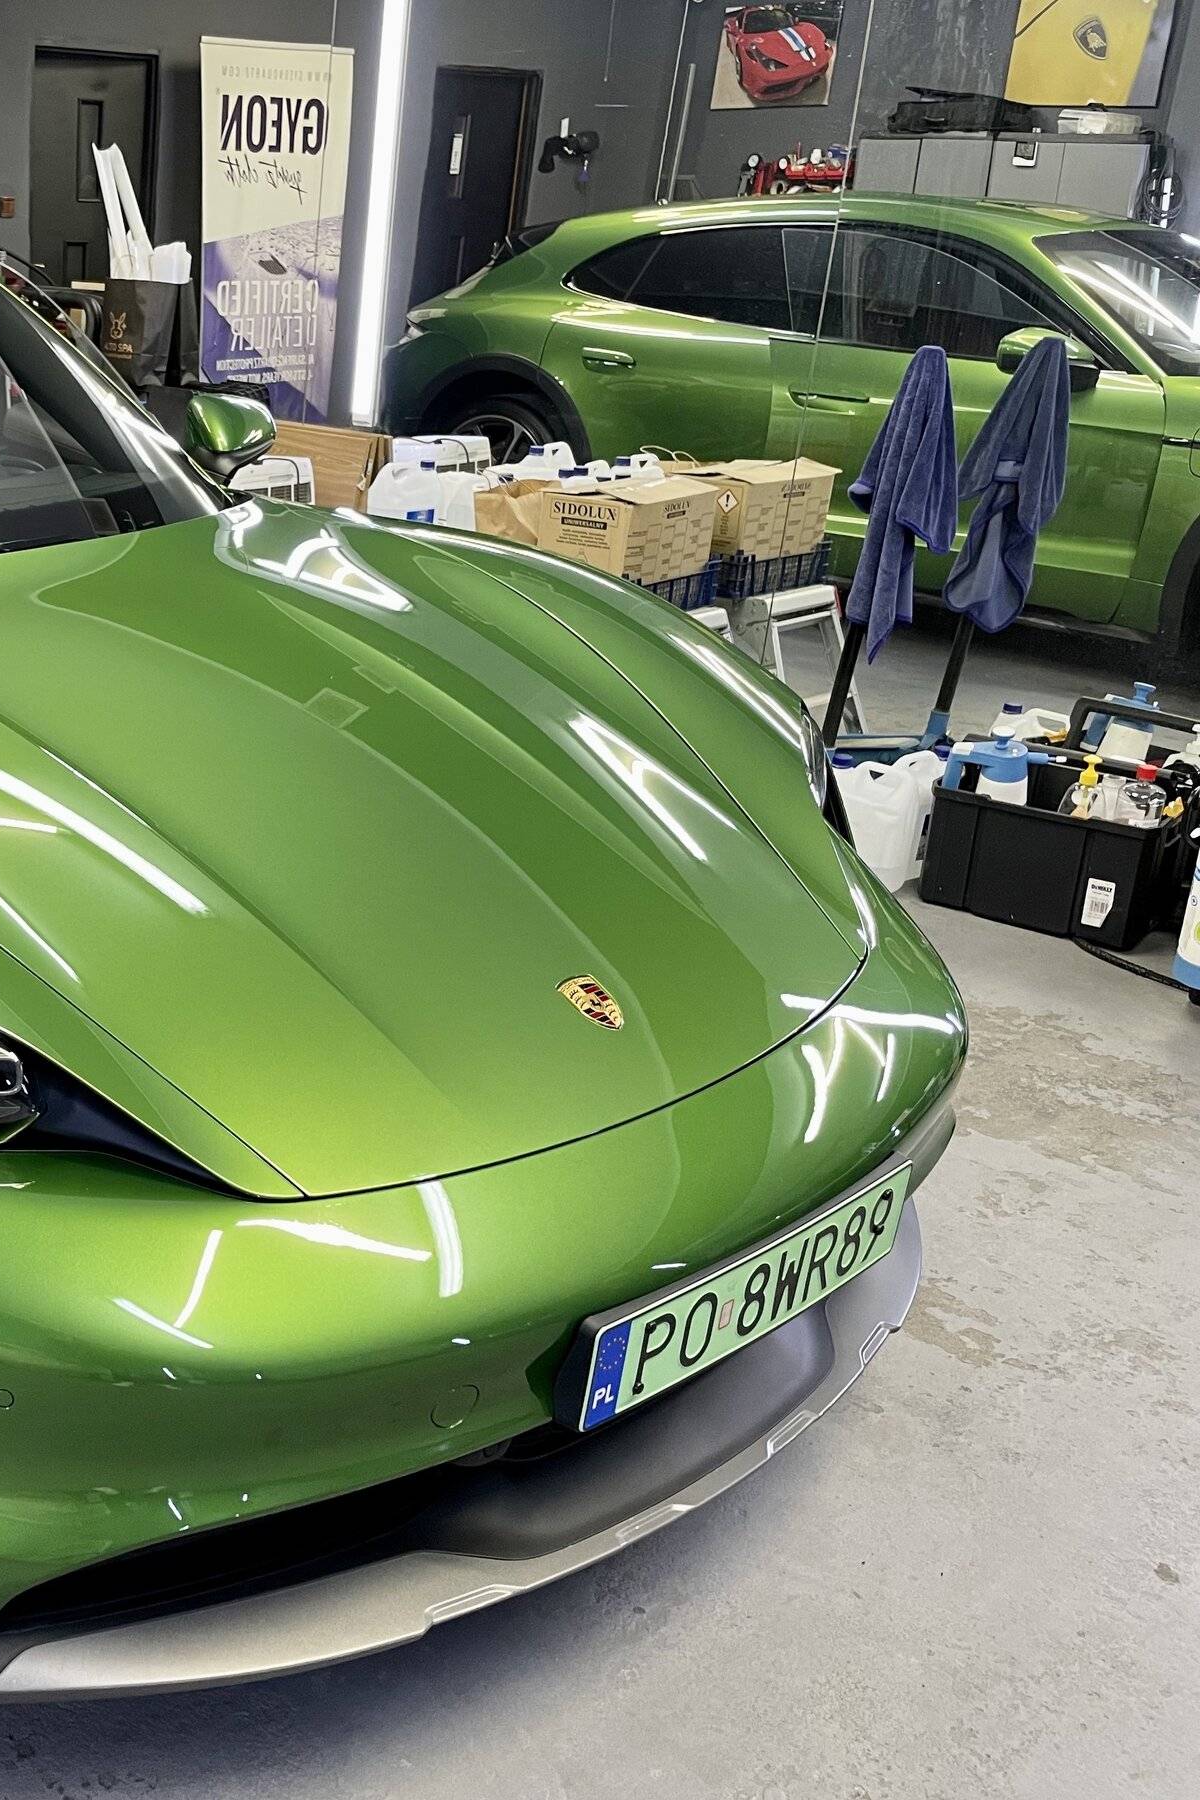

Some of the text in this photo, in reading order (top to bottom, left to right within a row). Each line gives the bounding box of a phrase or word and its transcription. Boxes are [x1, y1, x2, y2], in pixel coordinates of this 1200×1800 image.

[553, 501, 618, 521] SIDOLUX
[563, 518, 605, 529] UNIWERSALNY
[631, 1187, 895, 1396] PO 8WR89
[591, 1383, 615, 1410] PL
